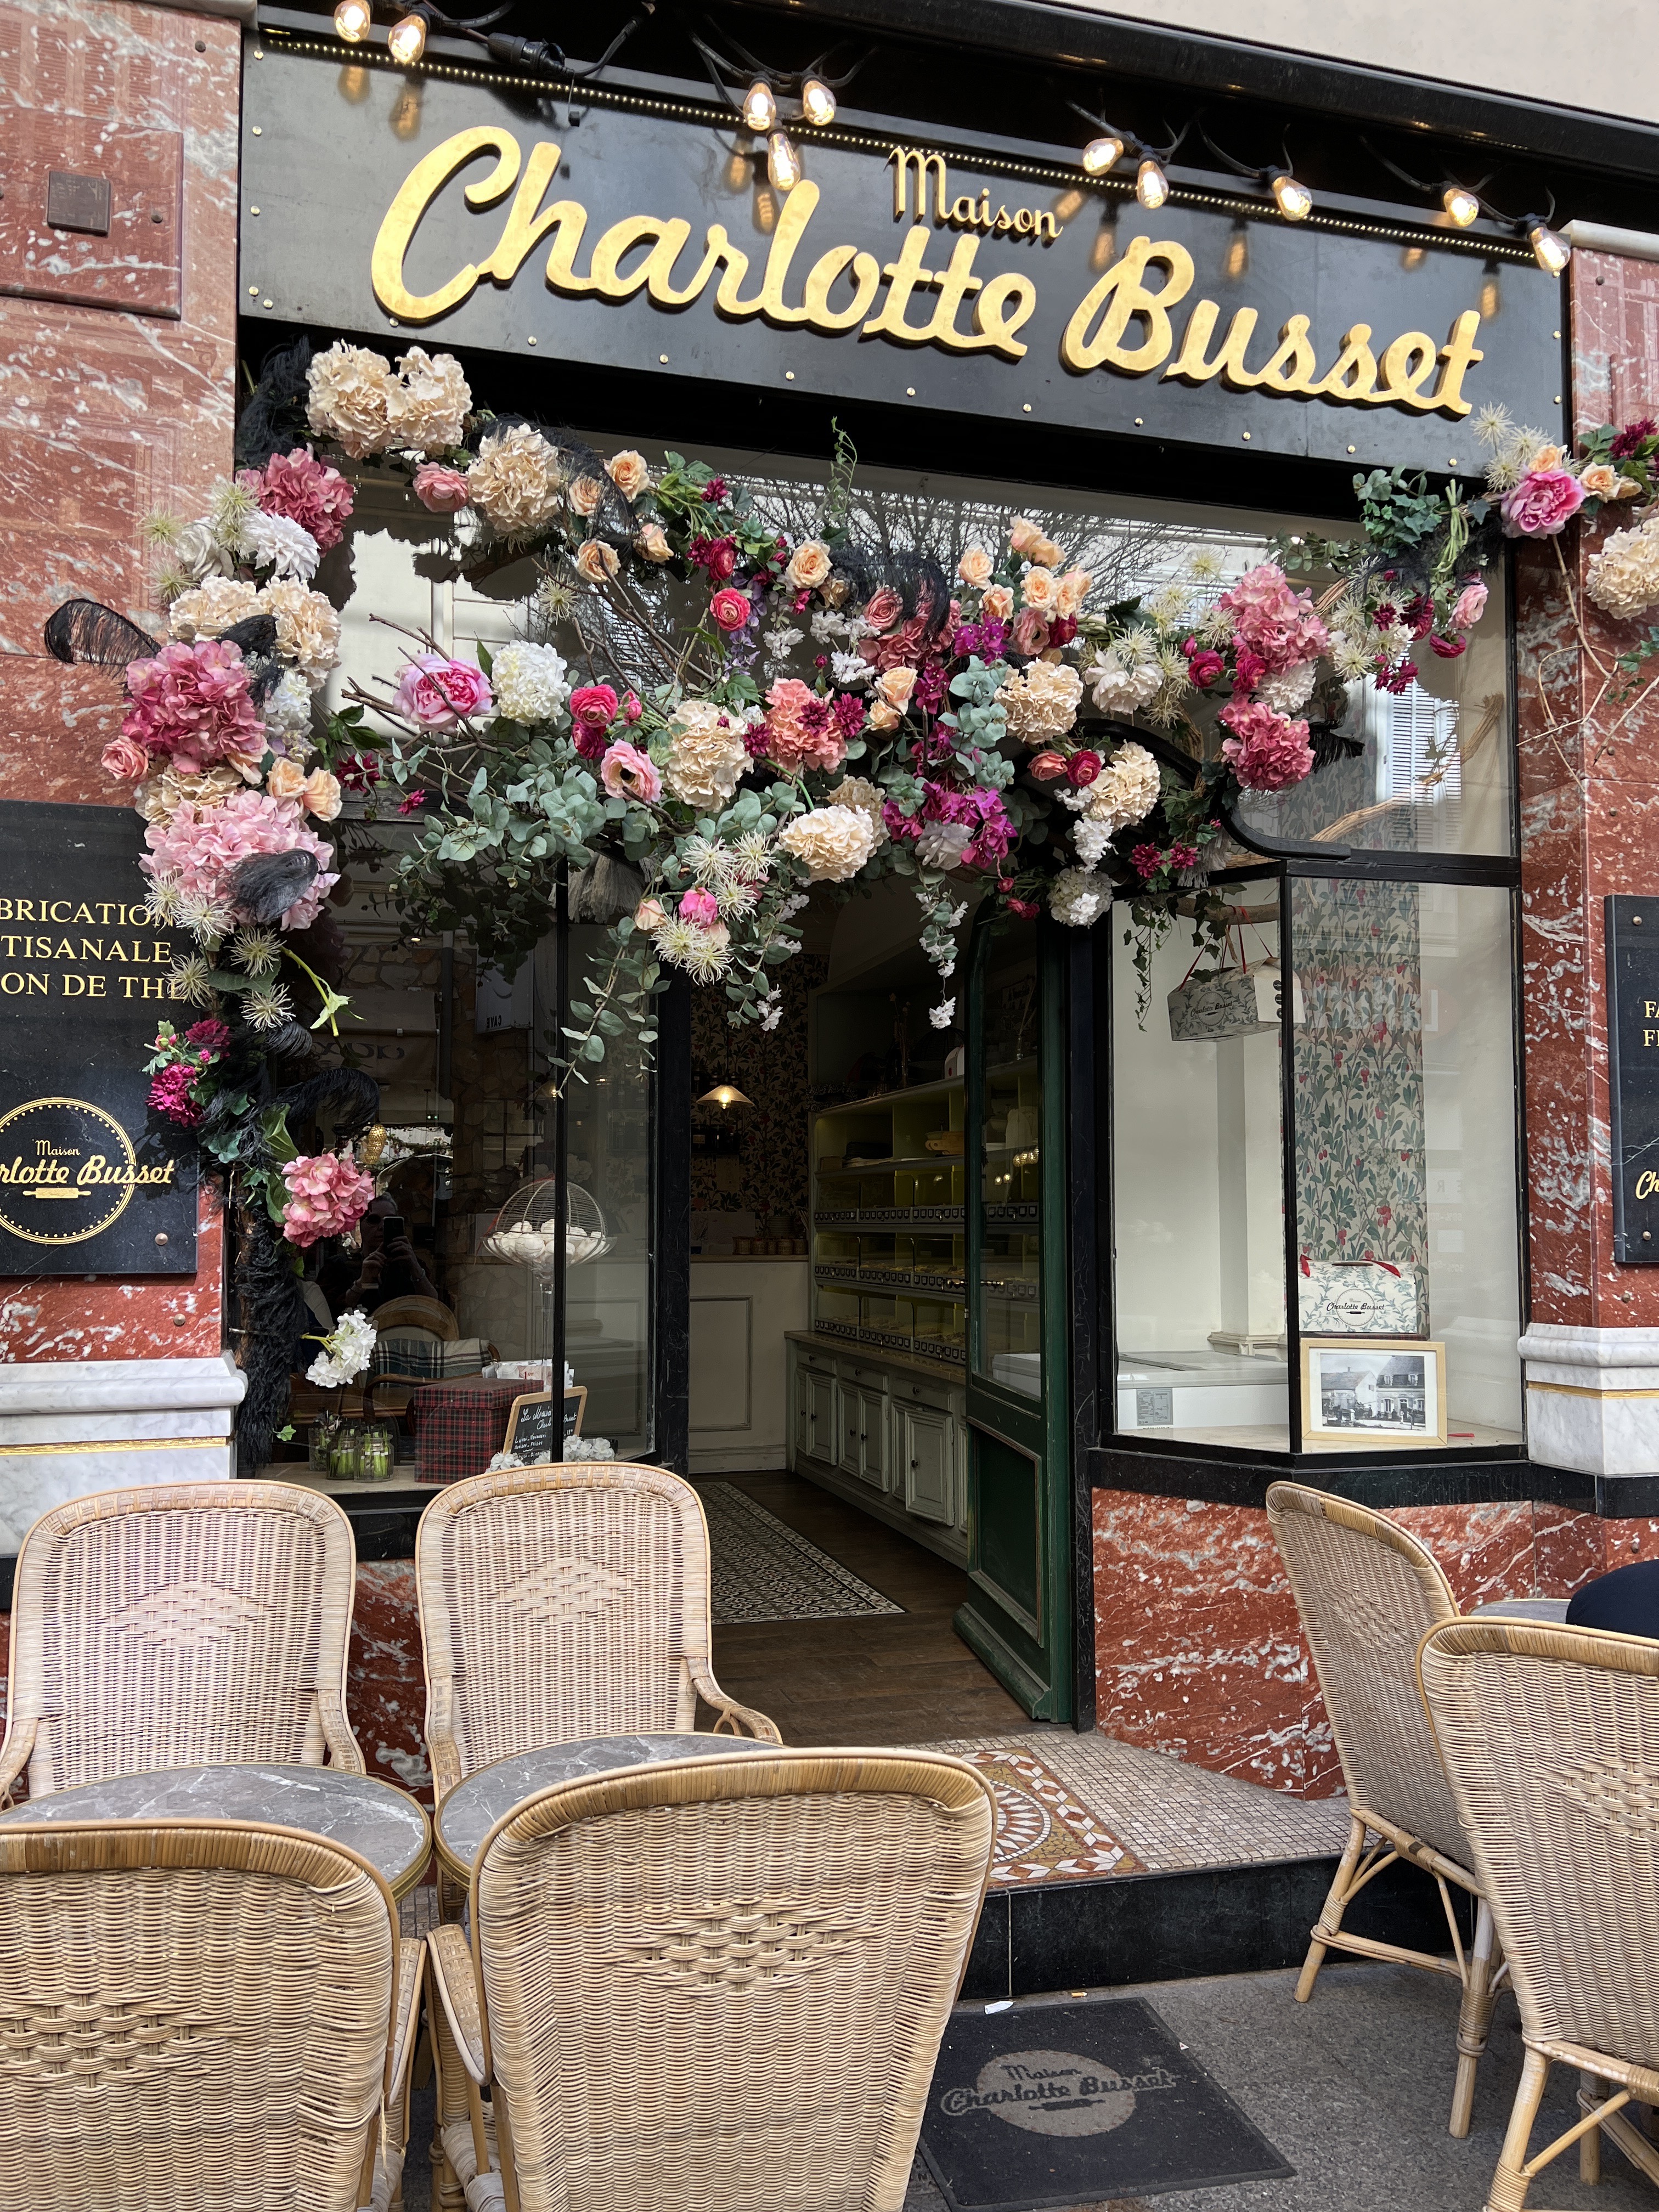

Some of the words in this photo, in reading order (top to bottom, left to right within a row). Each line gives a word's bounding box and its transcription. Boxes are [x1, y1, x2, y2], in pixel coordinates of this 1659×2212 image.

[889, 147, 1063, 241] Maison
[370, 125, 1037, 362] Charlotte
[1062, 235, 1485, 420] Busset
[0, 935, 172, 963] TISANALE
[1, 972, 50, 996] ON
[62, 974, 107, 997] DE
[35, 1139, 81, 1156] Maison
[76, 1155, 174, 1186] Busset
[1326, 1302, 1358, 1312] Charlotte
[941, 2082, 1071, 2116] Charlotte
